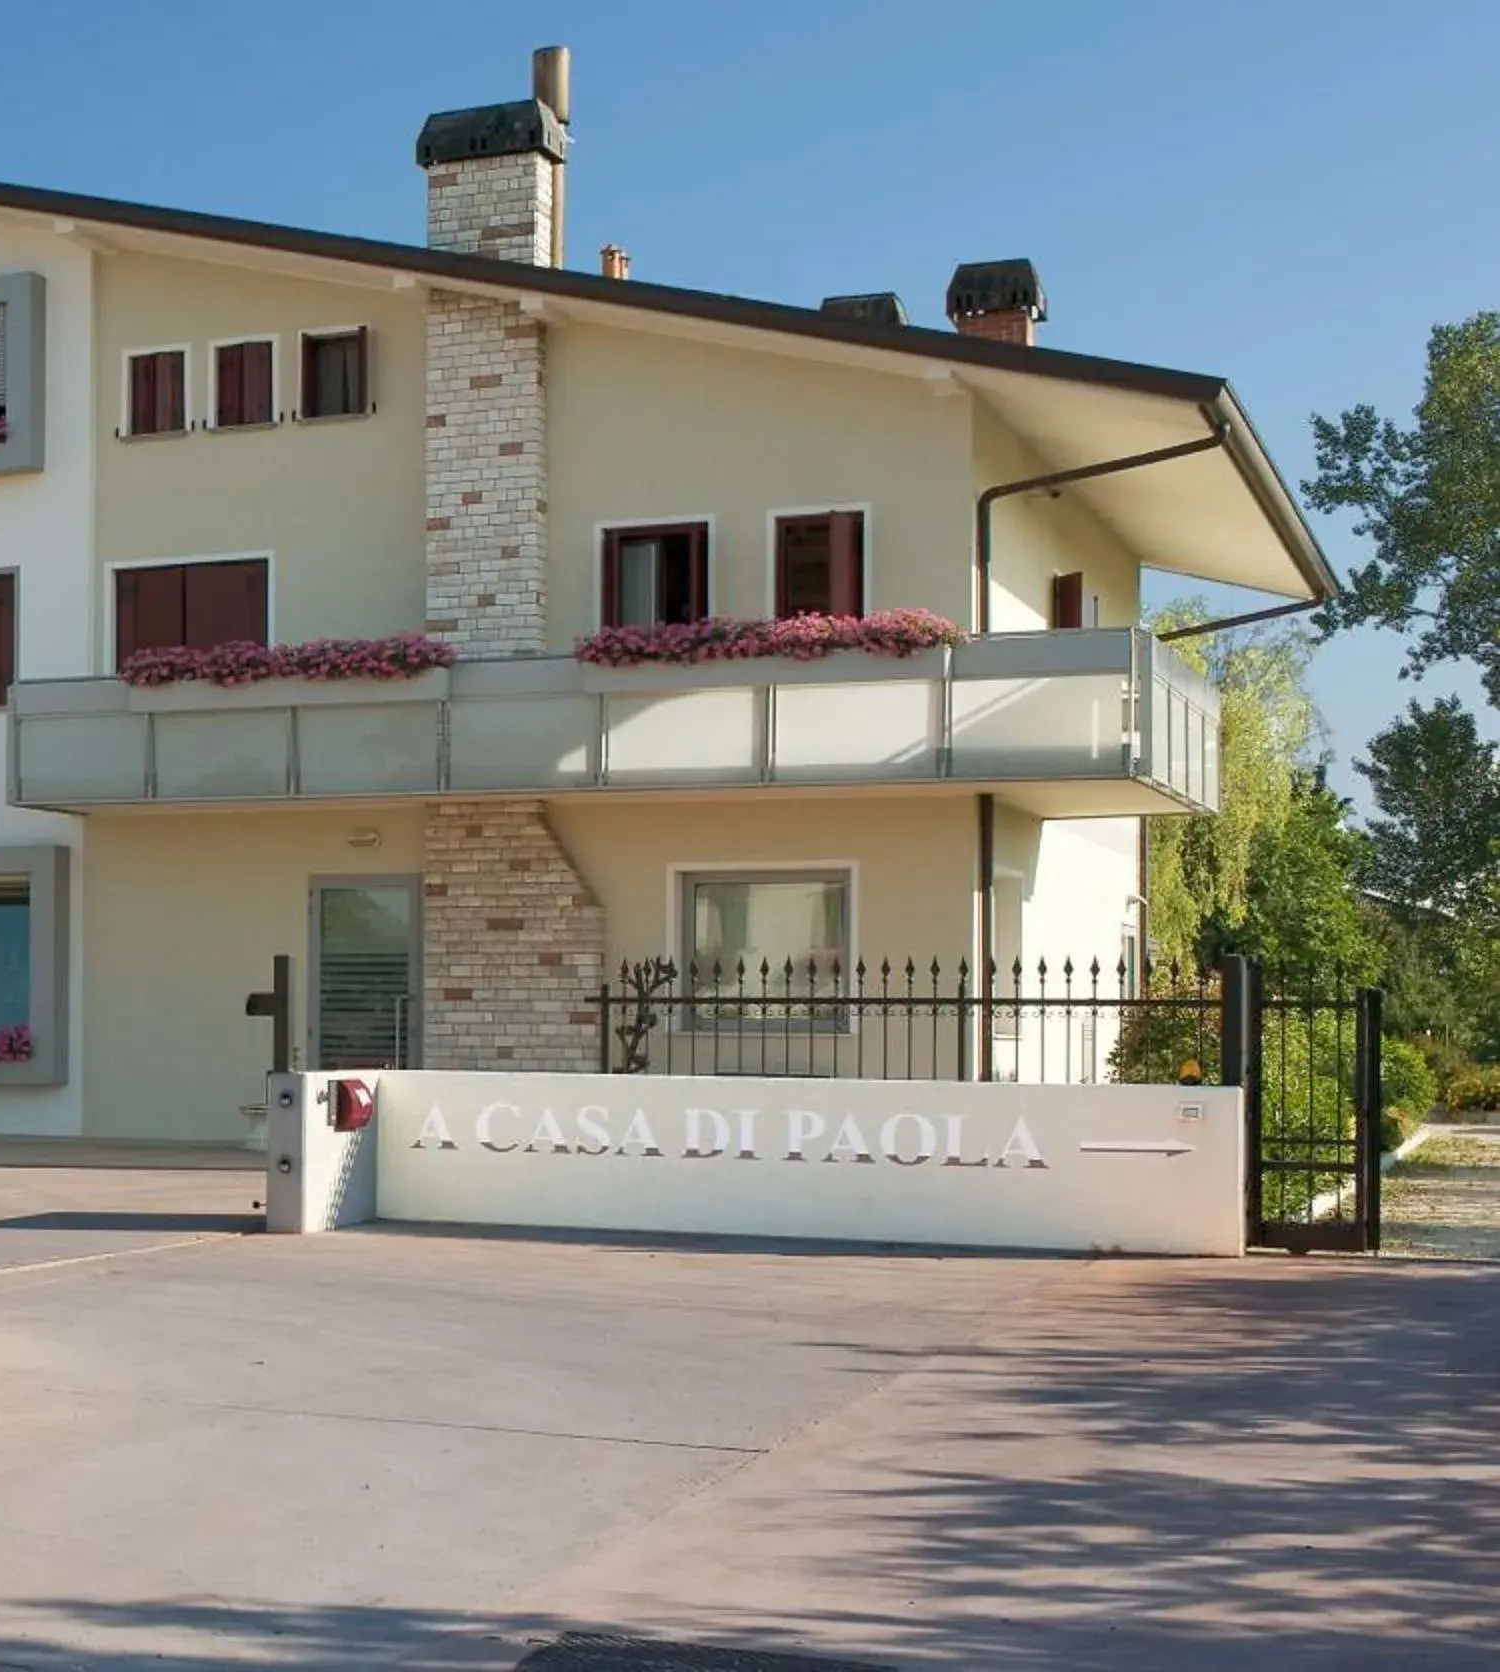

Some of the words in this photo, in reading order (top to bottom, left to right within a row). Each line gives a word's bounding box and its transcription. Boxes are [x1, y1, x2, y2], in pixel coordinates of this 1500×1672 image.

[408, 1102, 460, 1150] A
[474, 1103, 666, 1157] CASA
[680, 1106, 764, 1161] DI
[780, 1109, 1051, 1169] PAOLA
